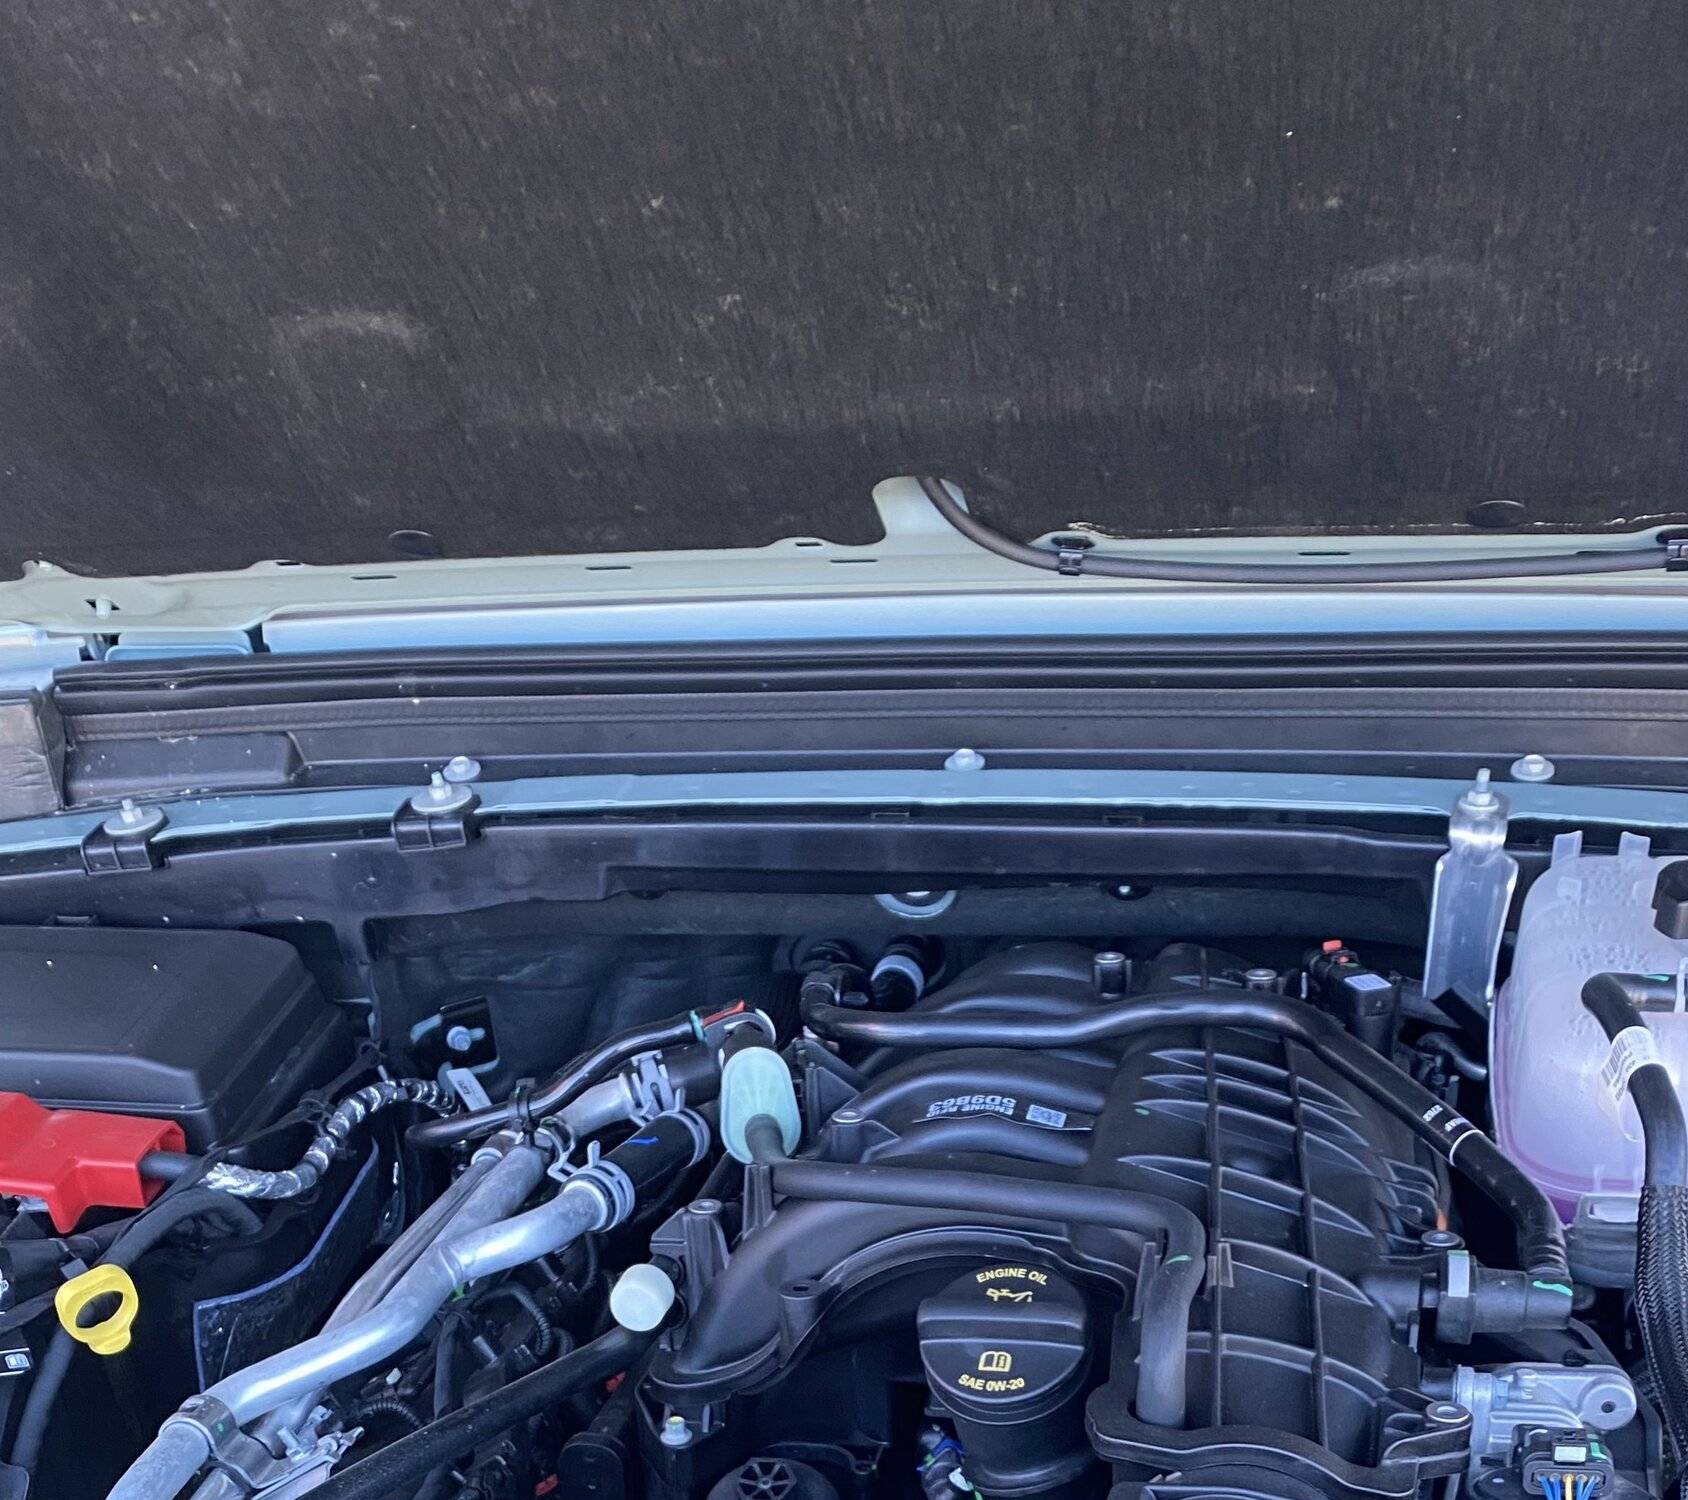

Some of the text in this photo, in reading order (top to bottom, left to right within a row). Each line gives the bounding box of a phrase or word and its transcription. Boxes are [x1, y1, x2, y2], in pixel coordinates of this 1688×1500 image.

[976, 1268, 1047, 1285] ENGINE OIL
[958, 1374, 1025, 1392] SAE 0W-20
